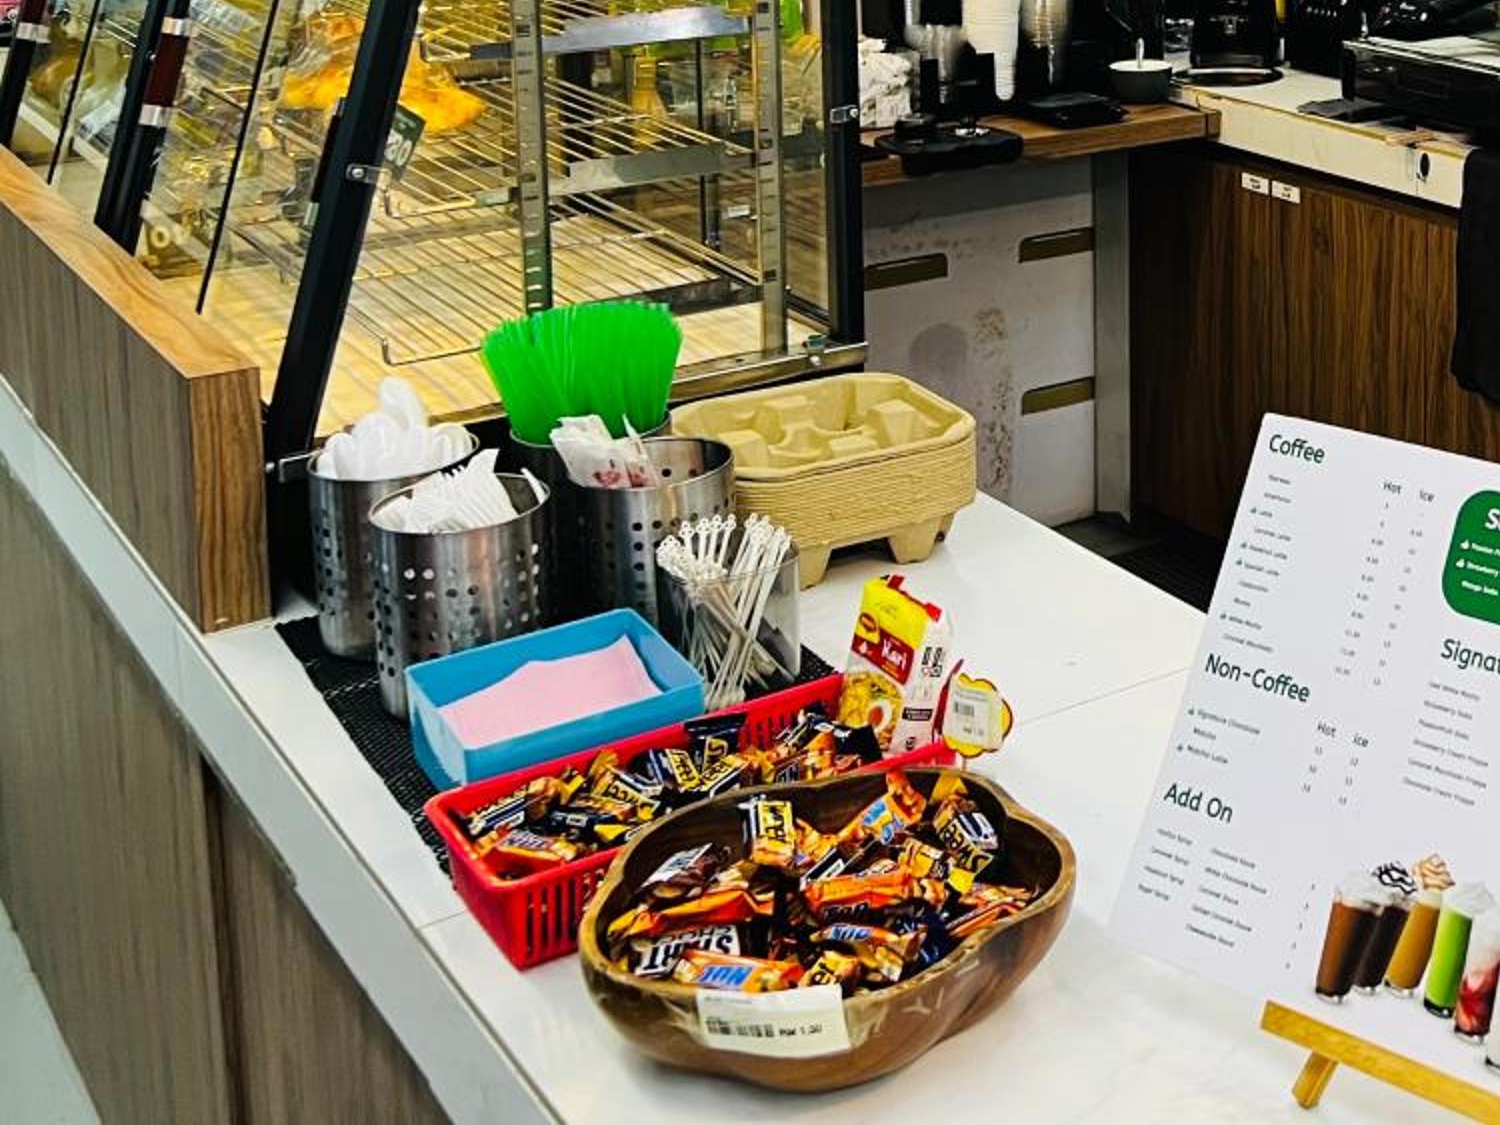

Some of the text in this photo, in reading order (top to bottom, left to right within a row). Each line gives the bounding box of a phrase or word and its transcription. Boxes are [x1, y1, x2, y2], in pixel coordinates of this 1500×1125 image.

[1268, 434, 1326, 464] Coffee
[1383, 481, 1402, 495] Hot
[1204, 654, 1311, 704] Non-Coffee
[1317, 721, 1337, 738] Hot
[1163, 782, 1234, 824] Add On
